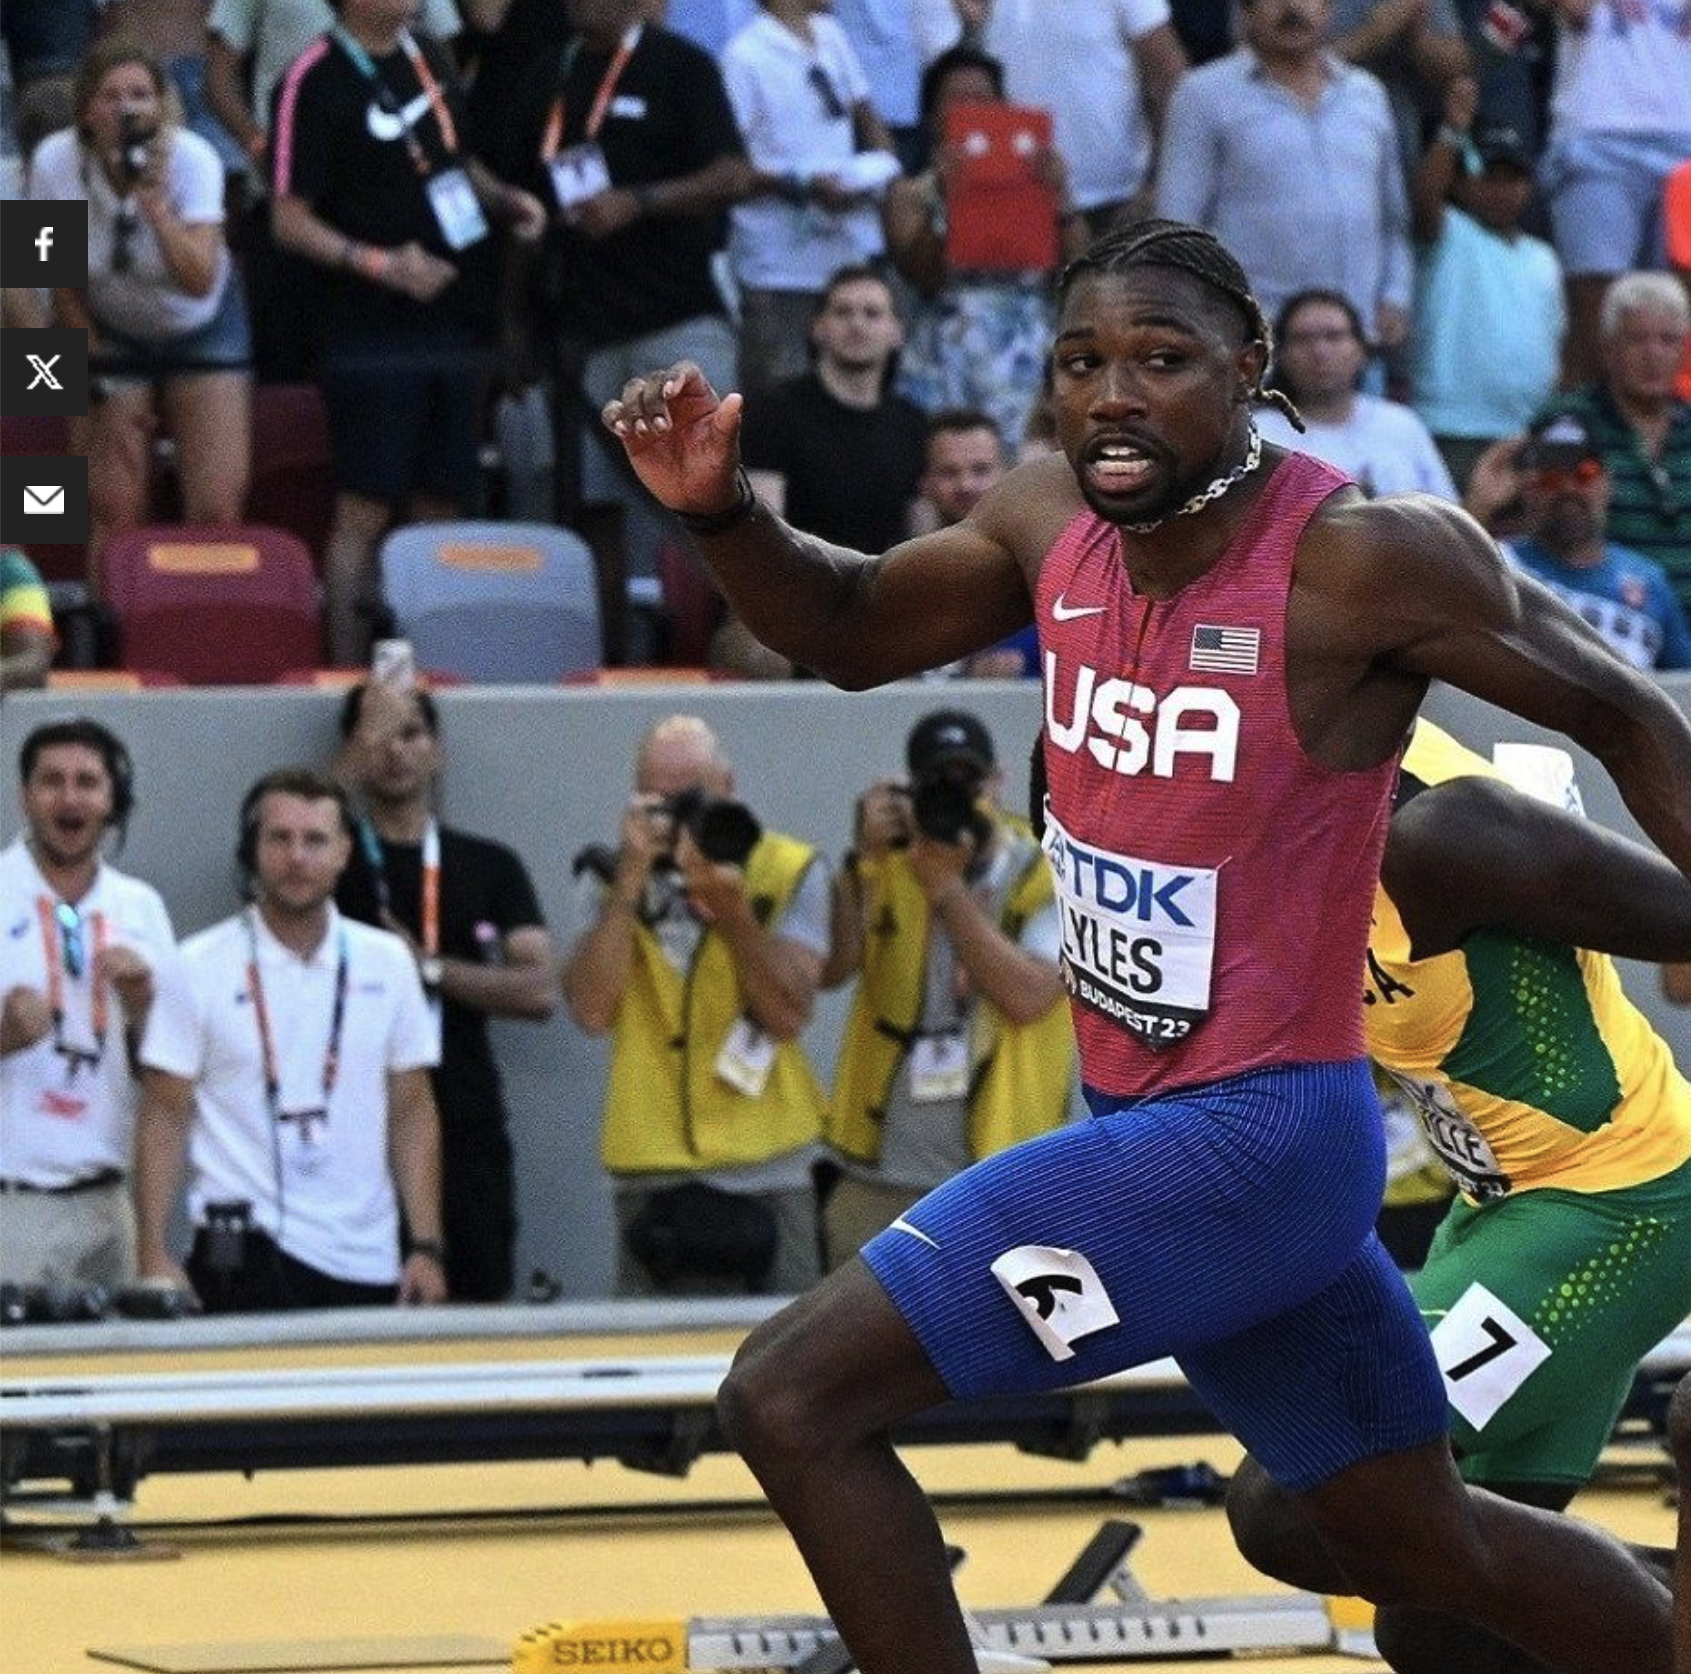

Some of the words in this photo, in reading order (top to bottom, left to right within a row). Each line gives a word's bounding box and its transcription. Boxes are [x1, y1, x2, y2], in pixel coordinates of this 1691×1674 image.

[1045, 649, 1241, 782] USA
[1066, 839, 1196, 928] TDK
[1060, 896, 1163, 994] LYLES
[1080, 980, 1159, 1035] BUDAPEST
[1160, 1018, 1191, 1039] 23
[1445, 1315, 1518, 1383] 7
[552, 1636, 675, 1666] SEIKO
